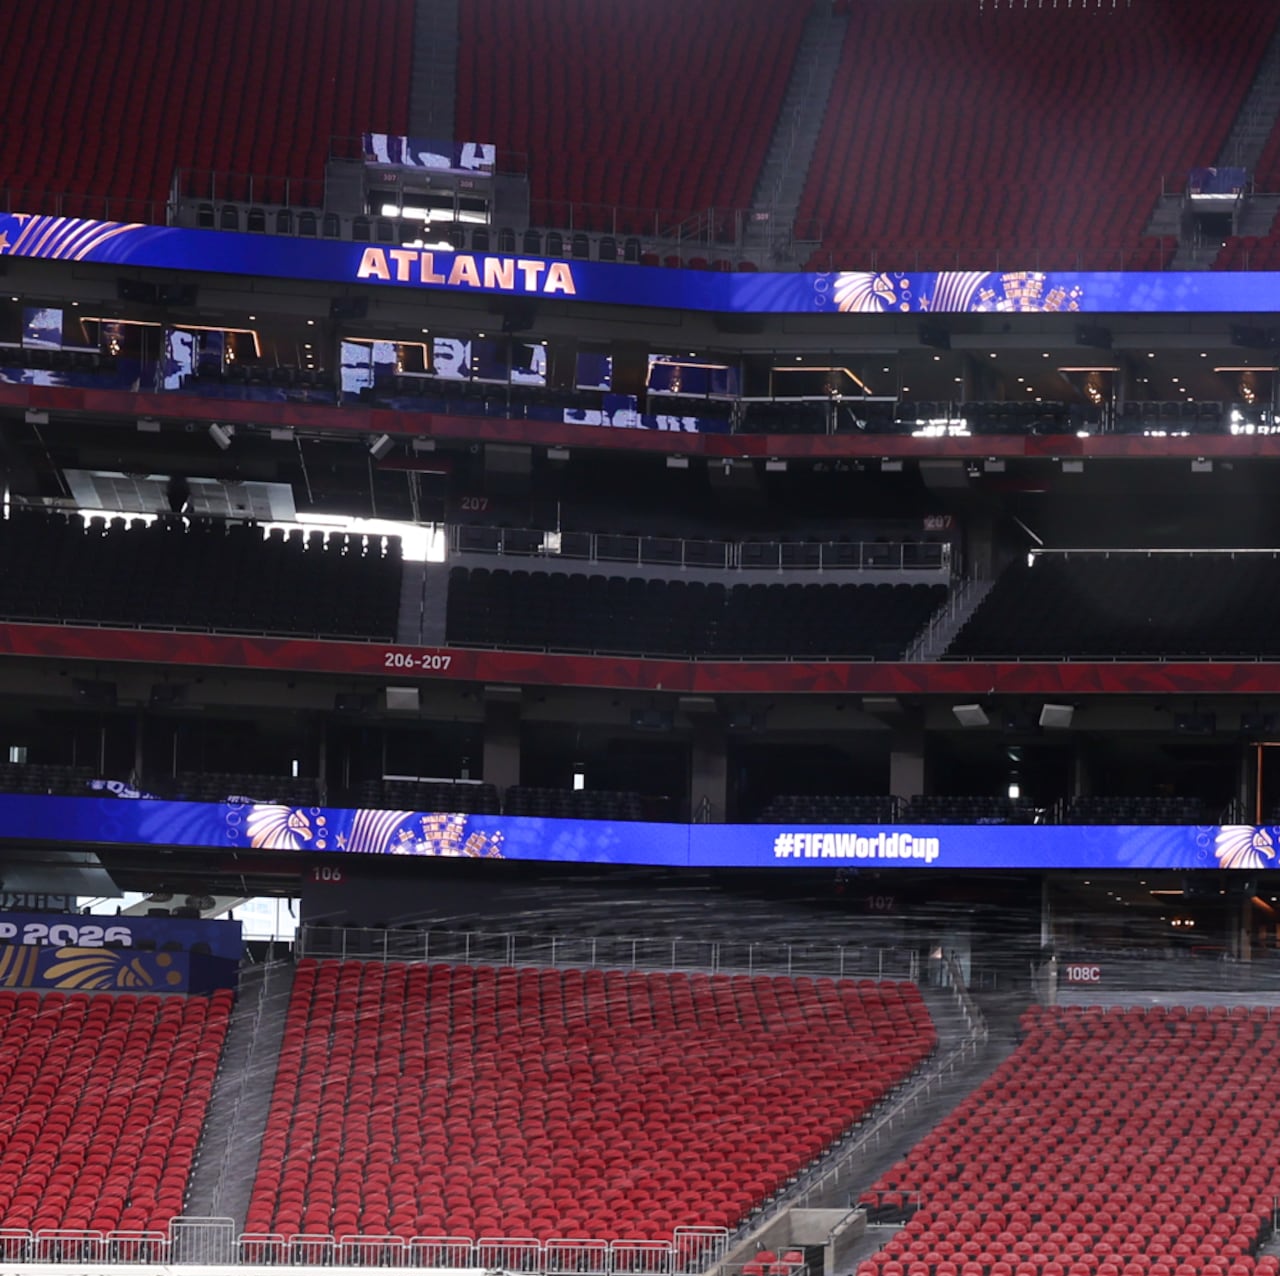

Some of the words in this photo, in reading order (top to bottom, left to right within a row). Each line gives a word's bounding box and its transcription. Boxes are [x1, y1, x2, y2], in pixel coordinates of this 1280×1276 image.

[357, 247, 576, 295] ATLANTA
[461, 496, 489, 511] 207
[927, 513, 953, 529] 207
[384, 652, 452, 670] 206-207
[773, 832, 940, 864] #FIFAWorldCup
[312, 866, 343, 881] 106
[867, 895, 896, 910] 107
[1065, 967, 1100, 981] 108C
